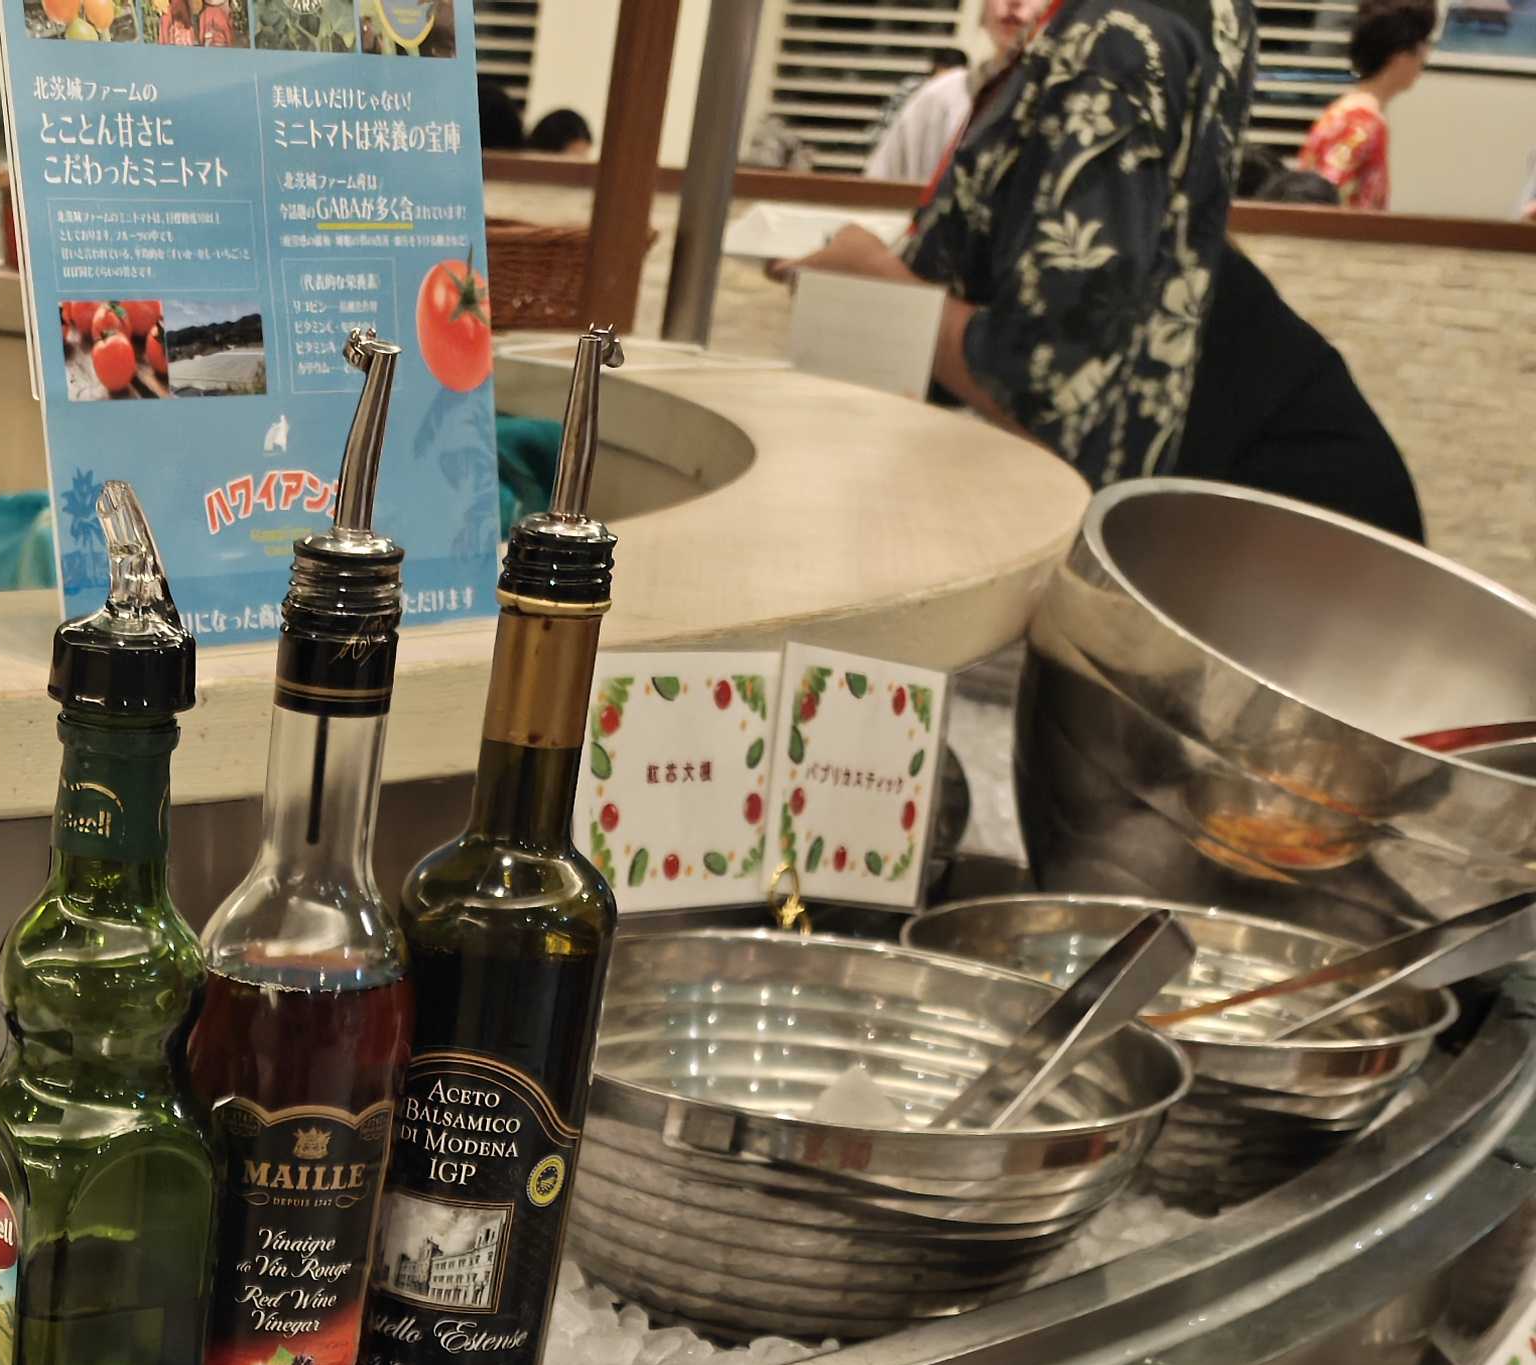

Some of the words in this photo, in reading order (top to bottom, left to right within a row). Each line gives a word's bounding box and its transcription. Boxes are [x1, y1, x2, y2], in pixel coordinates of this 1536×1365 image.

[34, 76, 157, 102] 北茨城ファームの
[40, 112, 174, 148] とことん甘さに
[274, 119, 461, 155] ミニトマトは栄養の宝庫
[43, 154, 228, 187] こだわったミニトマト
[427, 1079, 500, 1108] ACETO
[406, 1098, 521, 1134] BALSAMICO
[424, 1128, 519, 1158] MODENA
[242, 1159, 366, 1191] MAILLE
[429, 1158, 476, 1185] IGP
[258, 1228, 336, 1258] Vinaigre
[236, 1261, 251, 1273] de
[255, 1255, 288, 1277] Vin
[291, 1258, 352, 1283] Rouge
[234, 1285, 291, 1309] Red
[290, 1289, 337, 1309] Wine
[251, 1310, 321, 1338] Vinegar
[433, 1319, 528, 1354] Estense
